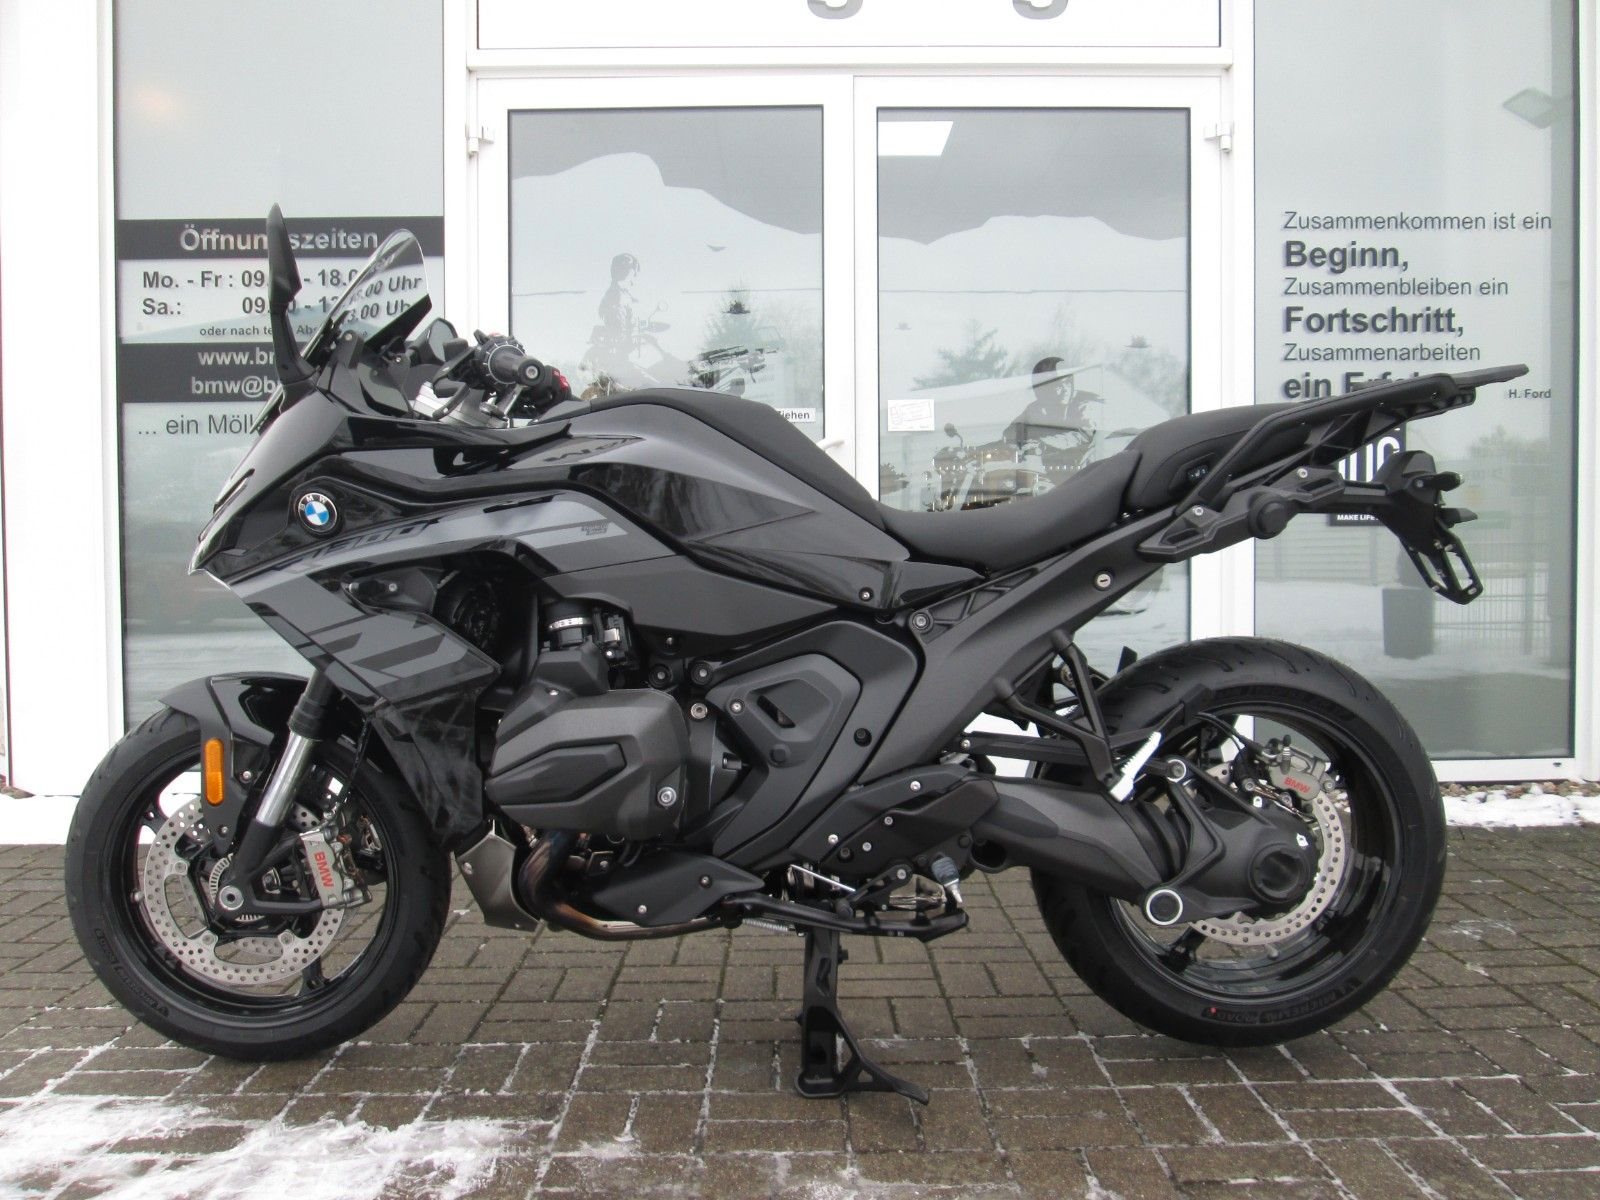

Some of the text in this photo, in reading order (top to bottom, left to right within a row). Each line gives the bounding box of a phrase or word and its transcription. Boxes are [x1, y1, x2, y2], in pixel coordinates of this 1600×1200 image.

[1283, 210, 1552, 230] Zusammenkommen ist ein
[180, 224, 378, 250] Öffnunszeiten
[1285, 240, 1408, 274] Beginn,
[142, 270, 179, 289] Mo.
[200, 269, 222, 288] Fr
[388, 275, 422, 292] Uhr
[1283, 276, 1509, 296] Zusammenbleiben ein
[199, 325, 227, 336] oder
[230, 325, 260, 336] nach
[1285, 306, 1464, 337] Fortschritt,
[1283, 343, 1481, 362] Zusammenarbeiten
[190, 376, 281, 398] bmw@b
[1283, 371, 1332, 398] ein
[1508, 388, 1552, 399] H. Ford
[166, 414, 199, 435] ein
[1284, 776, 1310, 793] BMW
[315, 851, 334, 887] BMW
